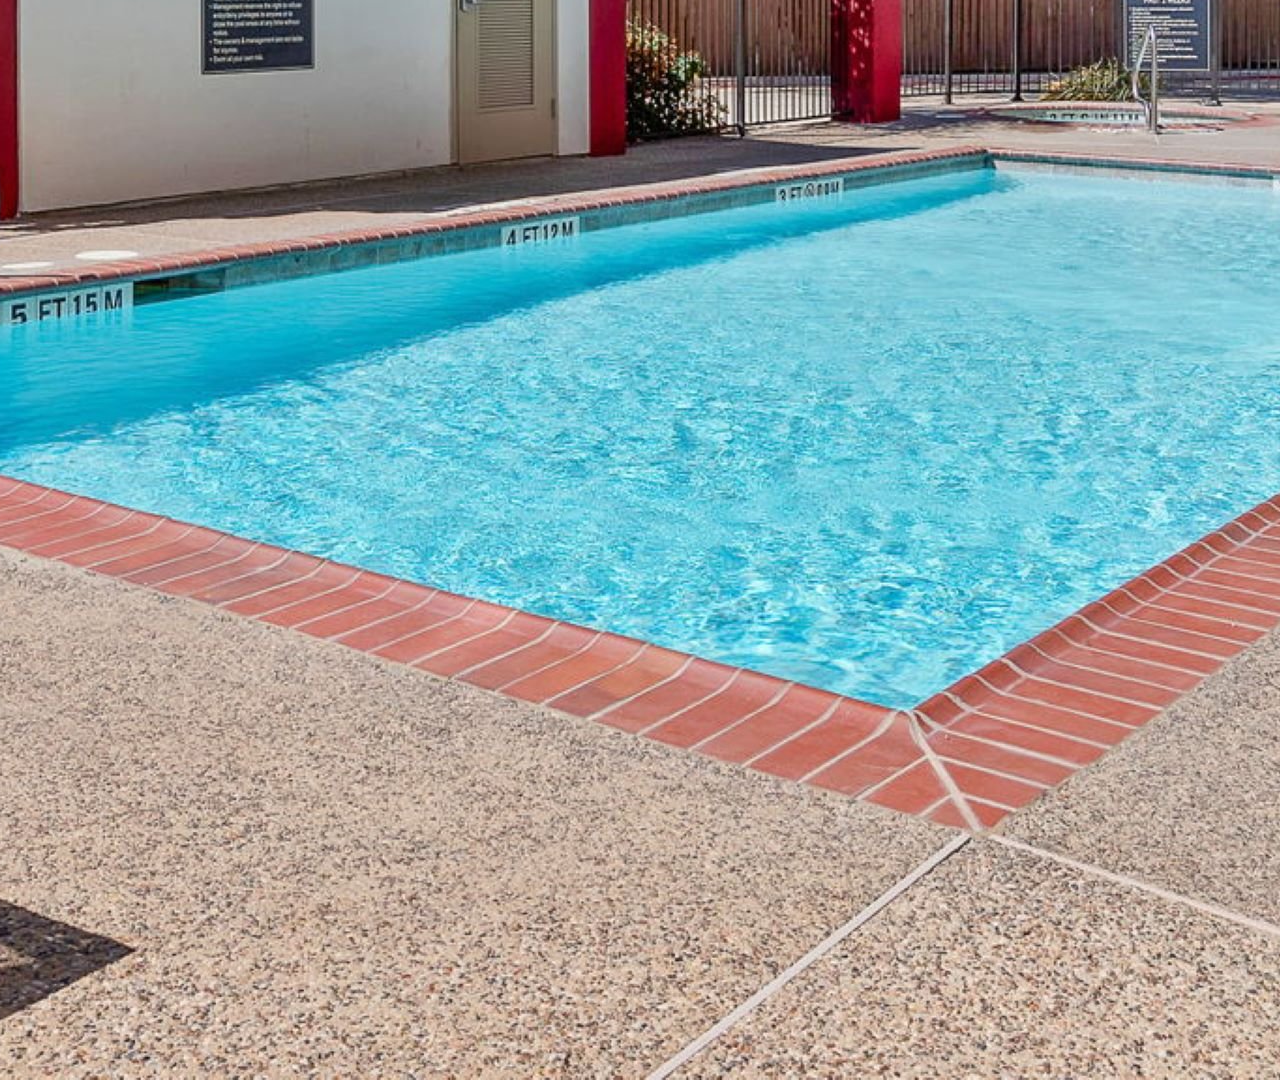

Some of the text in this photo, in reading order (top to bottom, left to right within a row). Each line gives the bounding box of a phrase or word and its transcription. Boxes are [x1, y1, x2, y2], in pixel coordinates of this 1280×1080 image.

[506, 229, 516, 246] 4
[523, 226, 539, 243] FT
[11, 302, 27, 324] 5
[39, 297, 66, 320] FT
